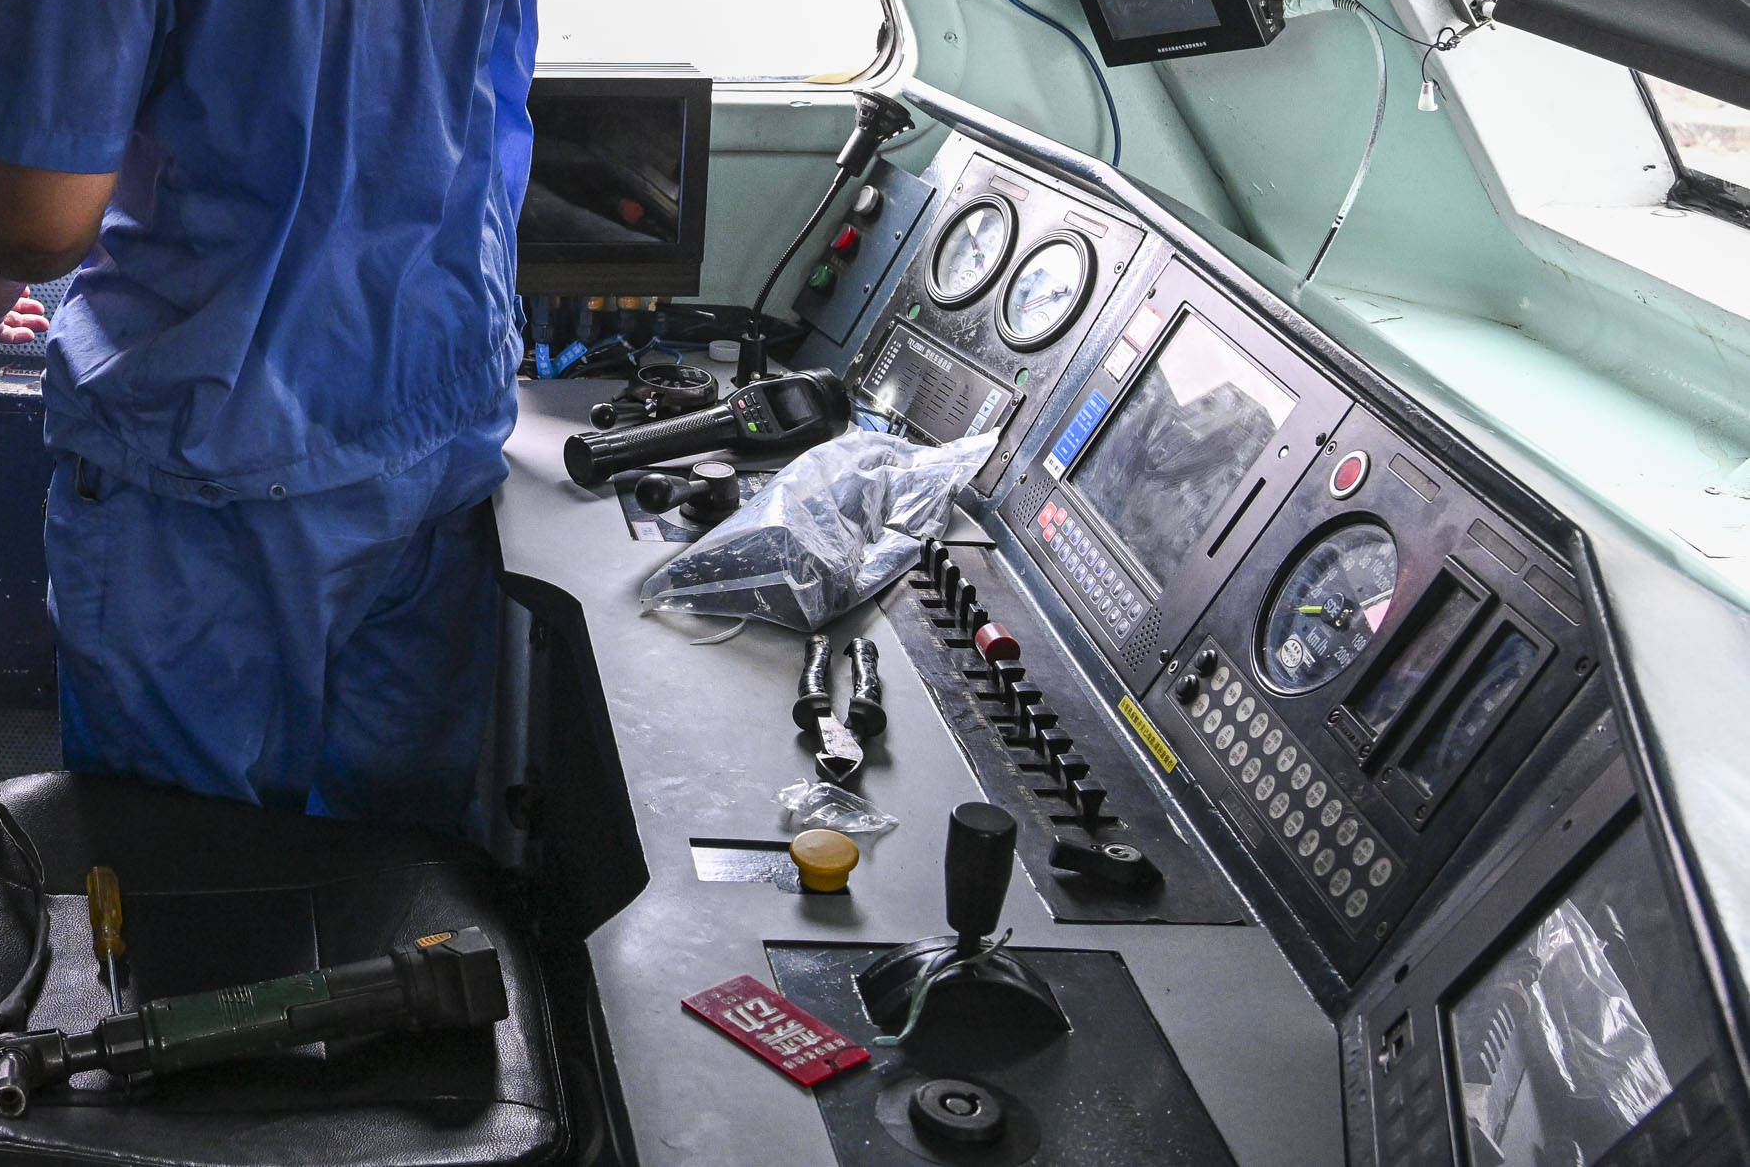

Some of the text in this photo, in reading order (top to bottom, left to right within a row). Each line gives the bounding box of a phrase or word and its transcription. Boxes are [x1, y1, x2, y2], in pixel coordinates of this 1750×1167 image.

[1305, 626, 1328, 657] km/h
[1351, 632, 1367, 652] 180
[721, 996, 825, 1057] 禁动
